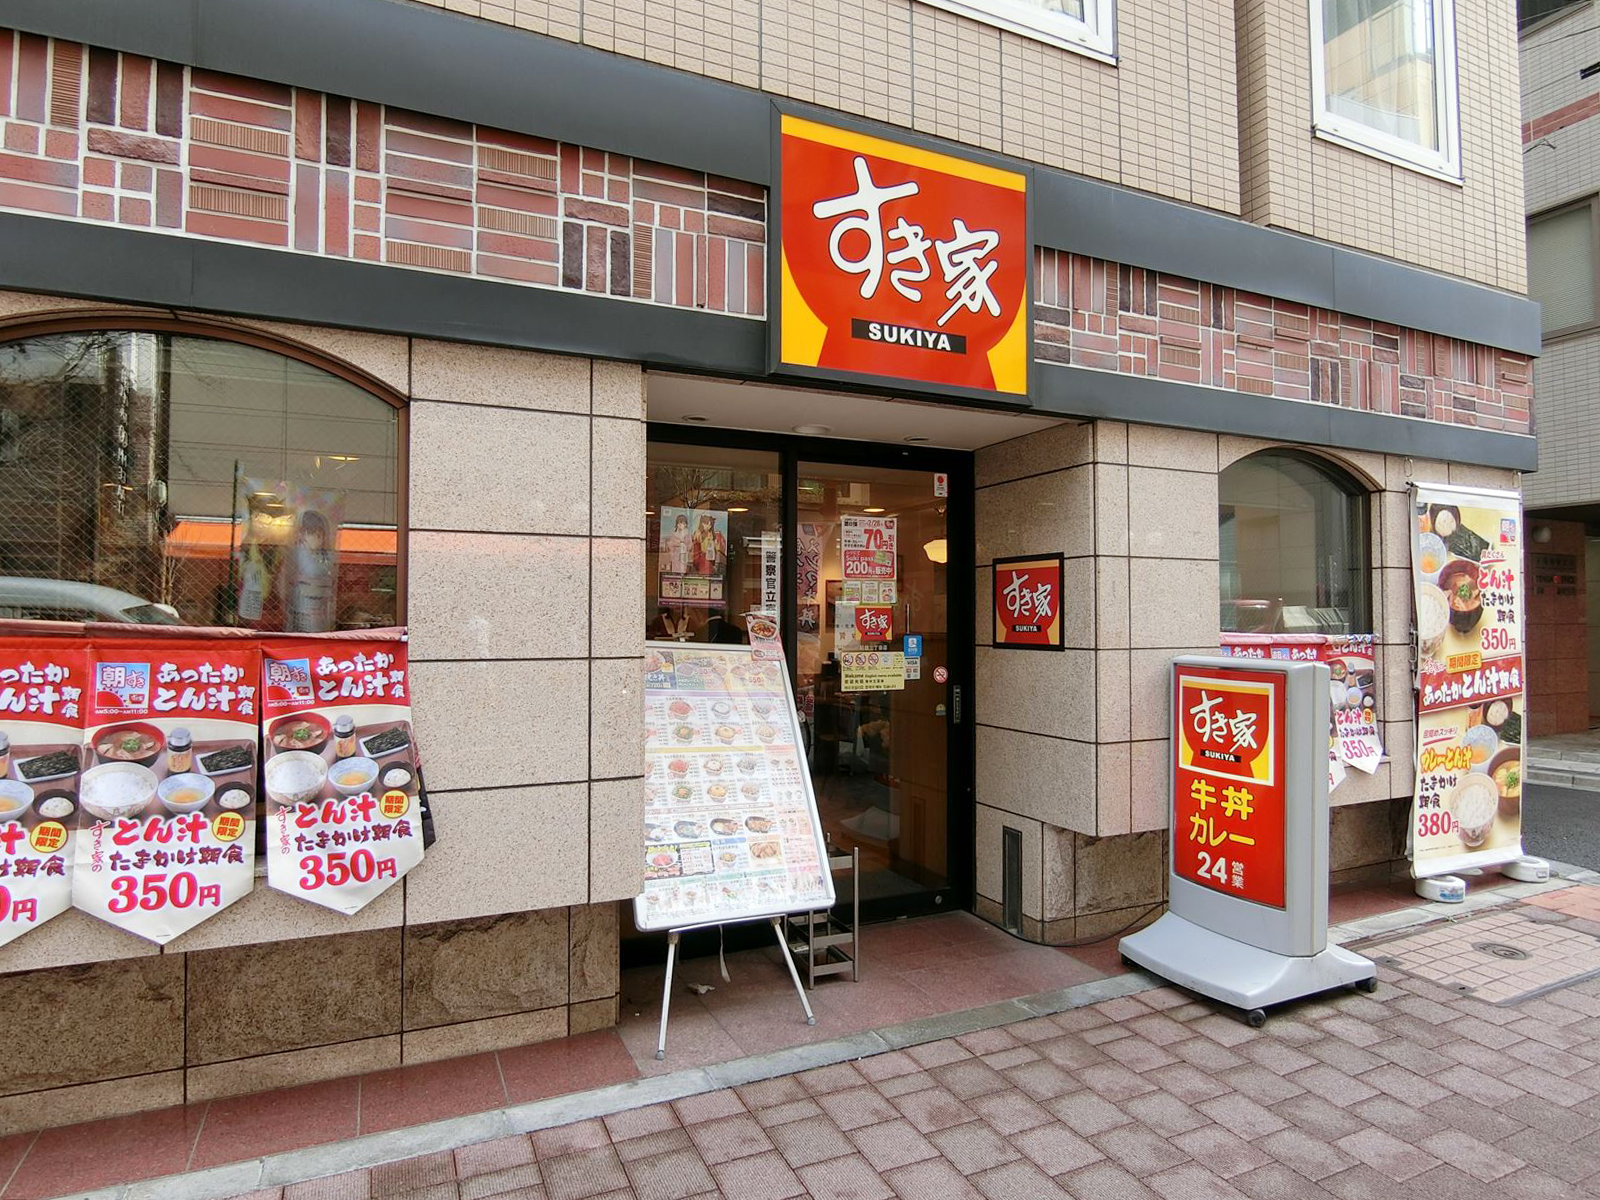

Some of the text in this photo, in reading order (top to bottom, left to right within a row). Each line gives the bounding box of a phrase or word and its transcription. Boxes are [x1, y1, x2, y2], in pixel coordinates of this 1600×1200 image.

[812, 155, 1001, 327] すき家
[868, 322, 952, 351] SUKIYA
[1478, 568, 1515, 591] とん汁
[1003, 571, 1052, 623] すき家
[859, 608, 889, 632] すき家
[1481, 627, 1516, 650] 350円
[157, 662, 245, 684] あったか
[315, 651, 394, 676] あったか
[1449, 653, 1479, 670] 期間限定
[153, 685, 236, 713] とん汁
[317, 671, 389, 701] とん汁
[1189, 690, 1257, 753] すき家
[1204, 750, 1236, 763] SUKIYA
[1422, 746, 1473, 772] カレーとん汁
[294, 794, 377, 829] とん汁
[1190, 779, 1255, 821] 牛丼
[112, 813, 208, 846] とん汁
[294, 818, 414, 852] たまかけ朝食
[1189, 812, 1256, 847] カレー
[1418, 811, 1460, 837] 380円
[109, 844, 245, 872] たまかけ朝食
[299, 848, 398, 891] 350円
[1197, 851, 1228, 884] 24
[1231, 861, 1244, 890] 営業
[107, 871, 222, 914] 350円
